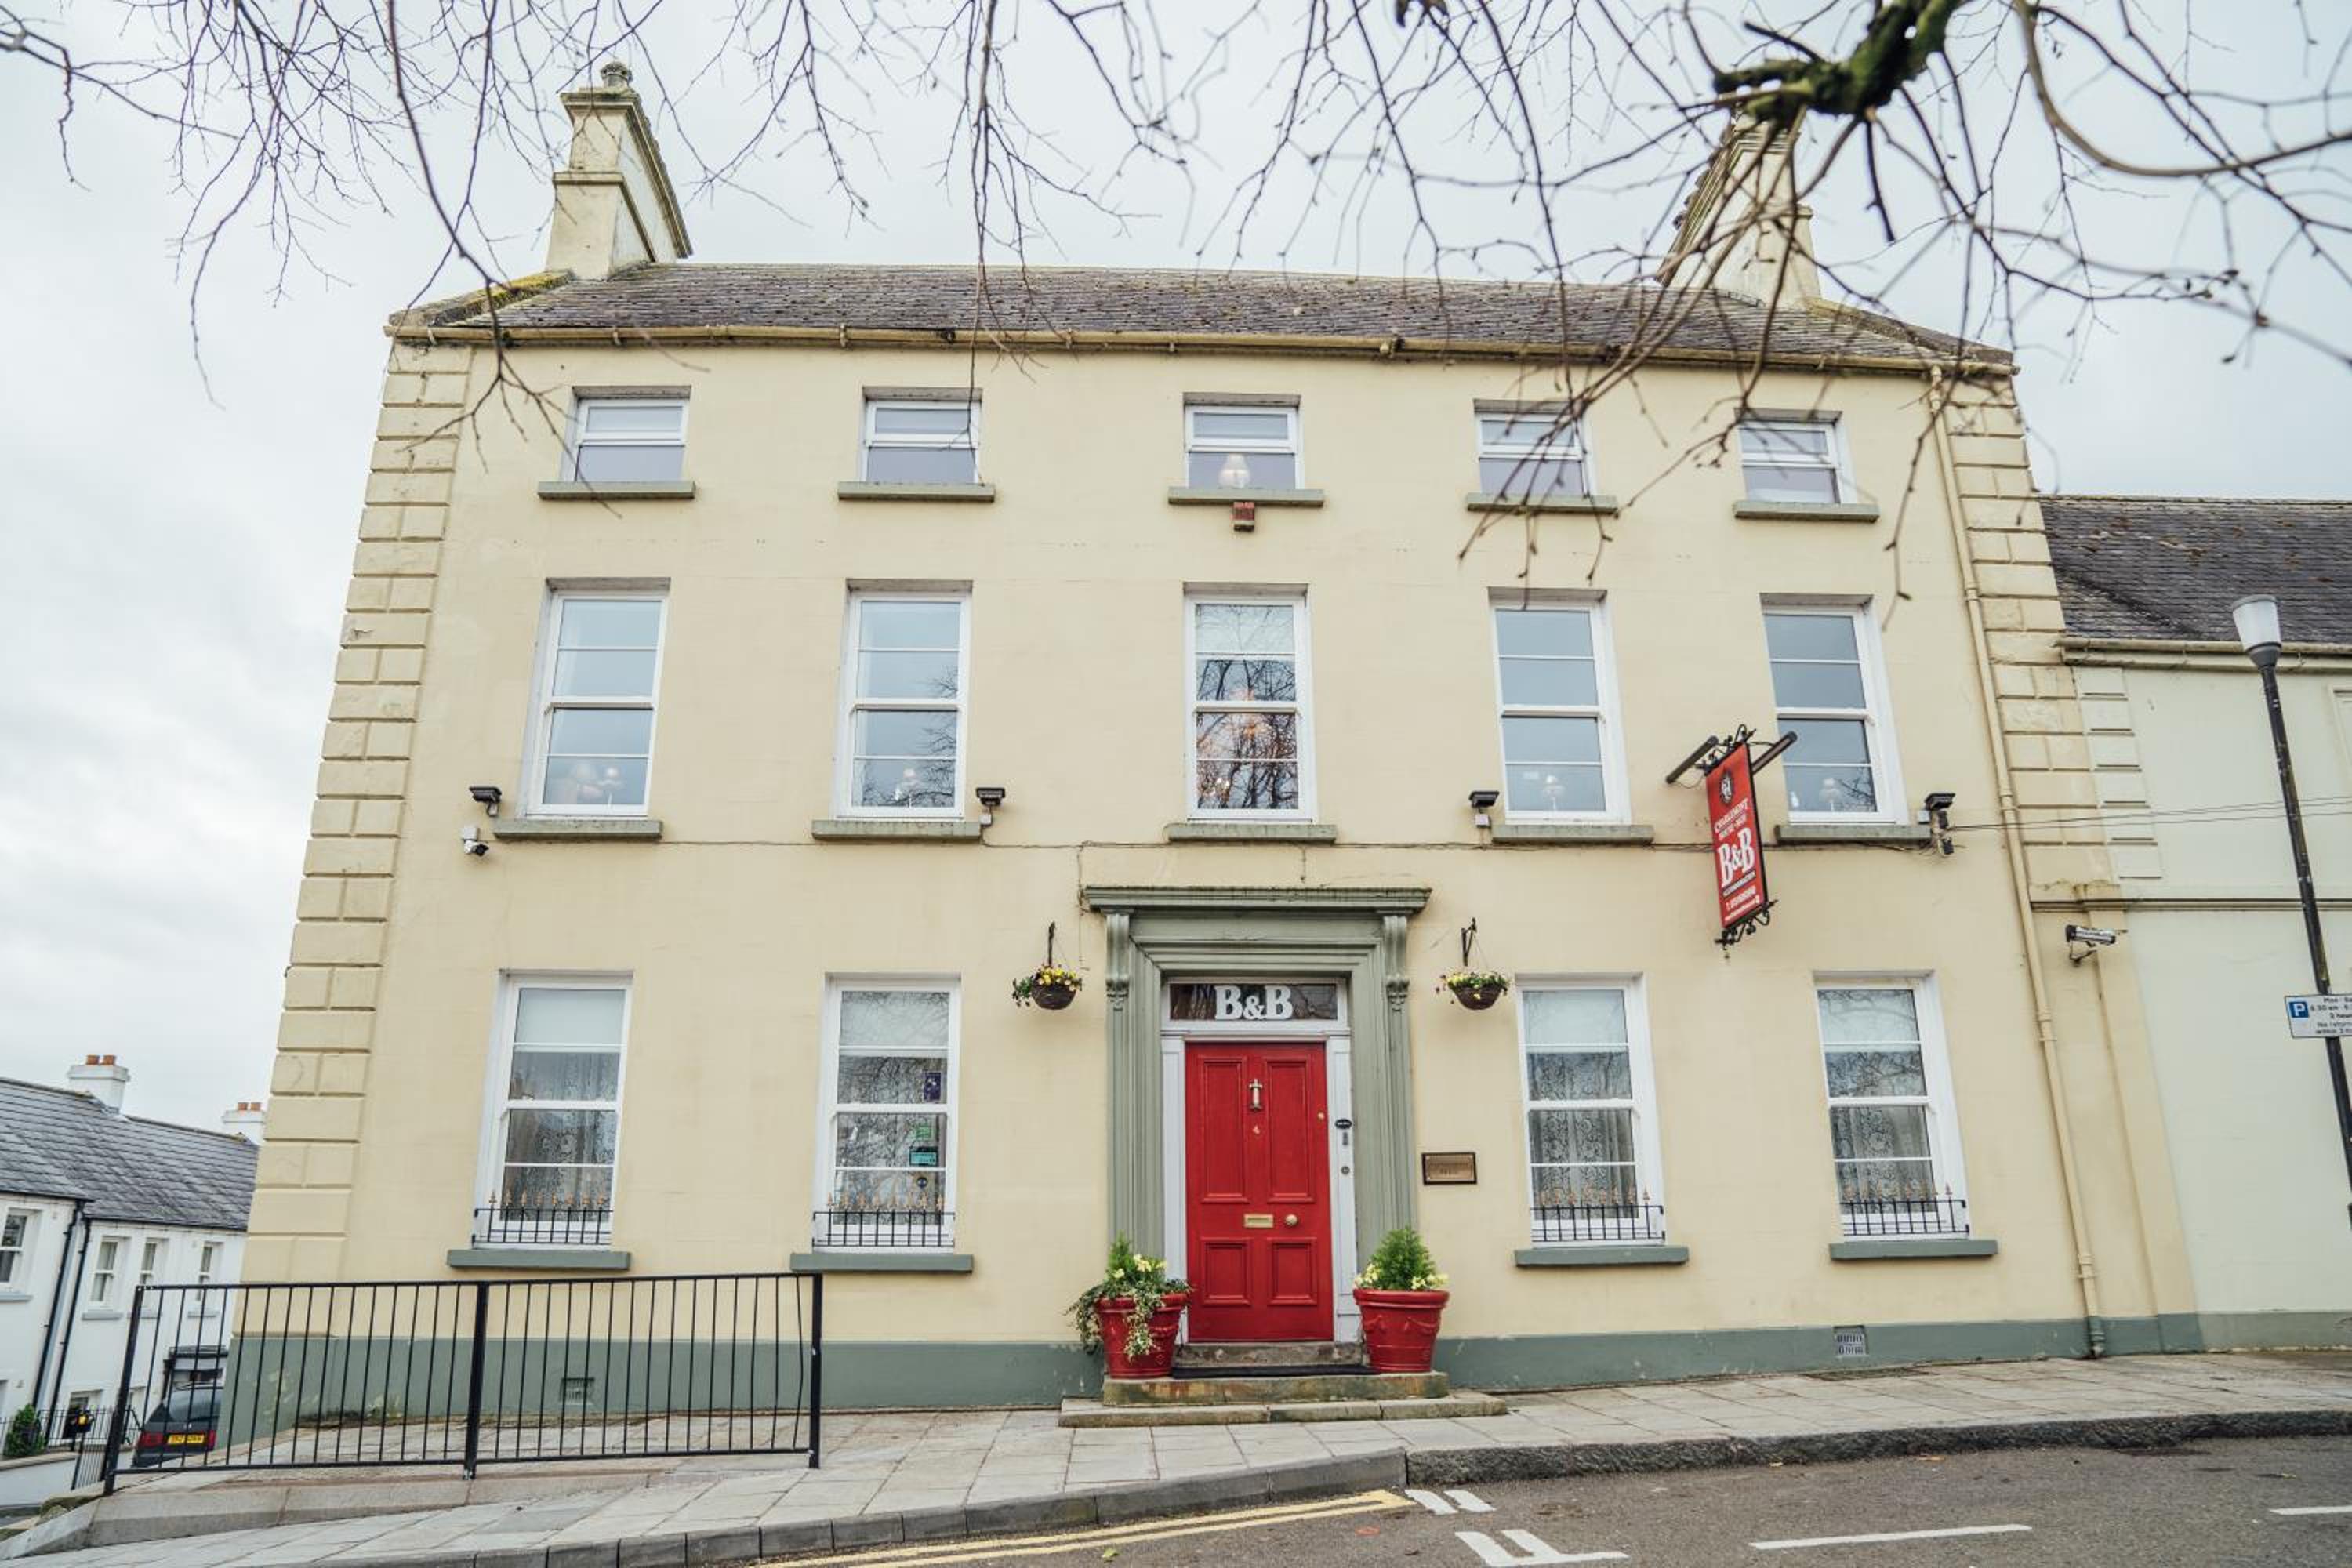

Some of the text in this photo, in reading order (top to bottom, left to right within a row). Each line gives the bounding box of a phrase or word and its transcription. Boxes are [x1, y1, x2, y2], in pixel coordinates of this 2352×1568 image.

[1717, 827, 1755, 887] B&B
[1215, 985, 1294, 1020] B&B
[2293, 1003, 2306, 1017] P
